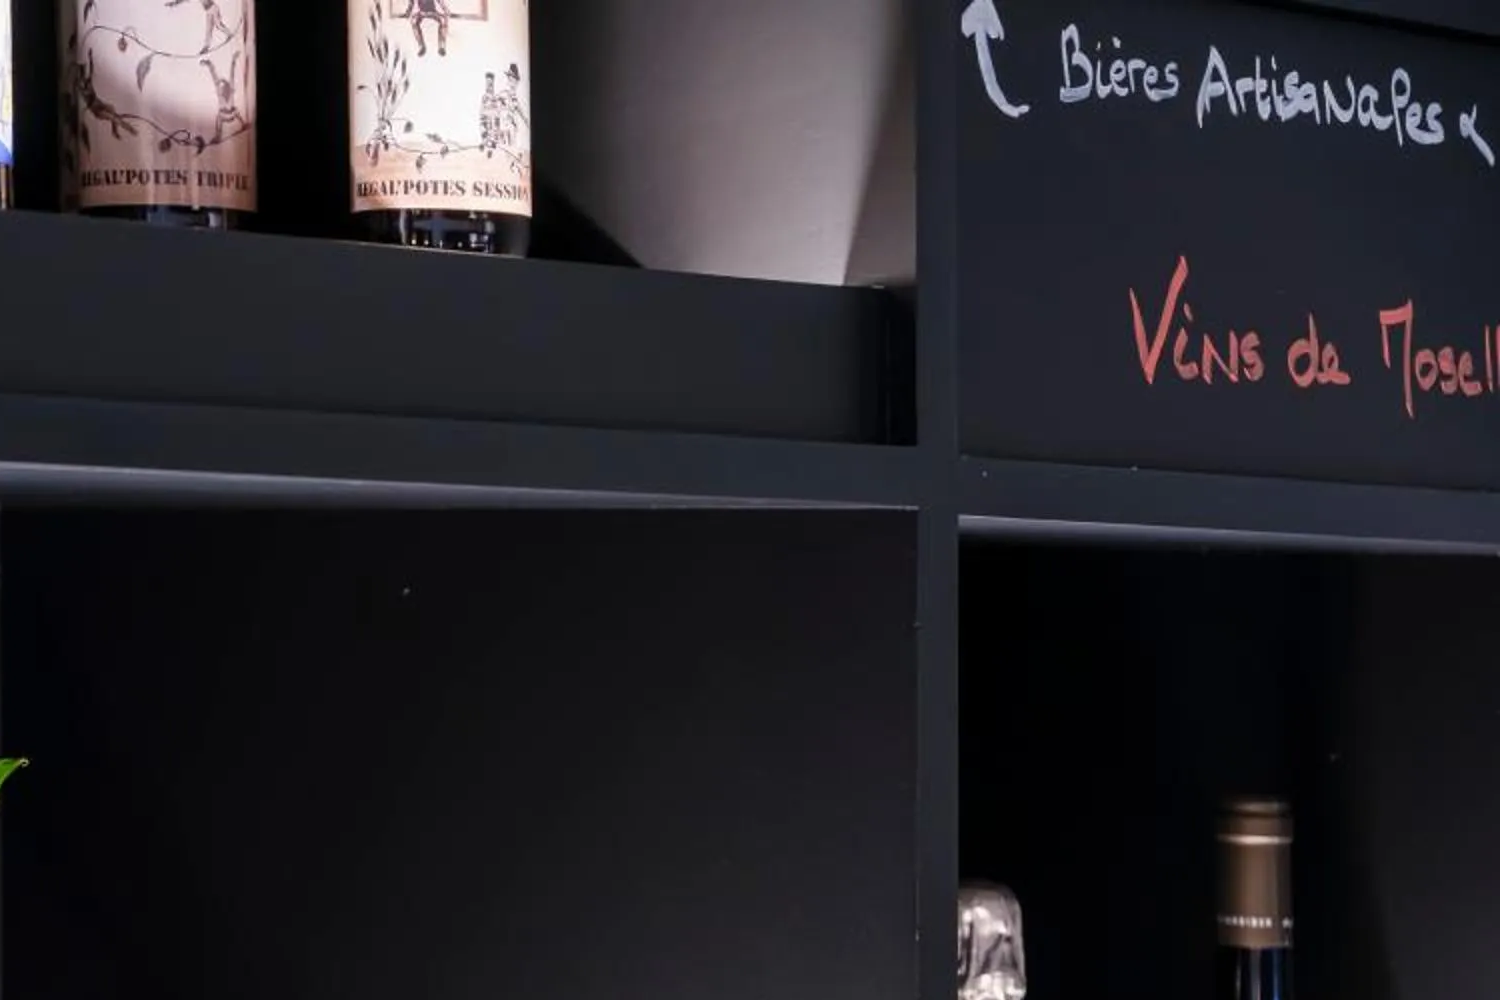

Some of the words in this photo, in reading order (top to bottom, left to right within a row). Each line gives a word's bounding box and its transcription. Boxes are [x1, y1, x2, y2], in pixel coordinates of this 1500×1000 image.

[1059, 22, 1180, 103] Bières
[1196, 44, 1446, 147] Artisanales
[1128, 255, 1265, 386] Vins
[1287, 311, 1352, 389] de
